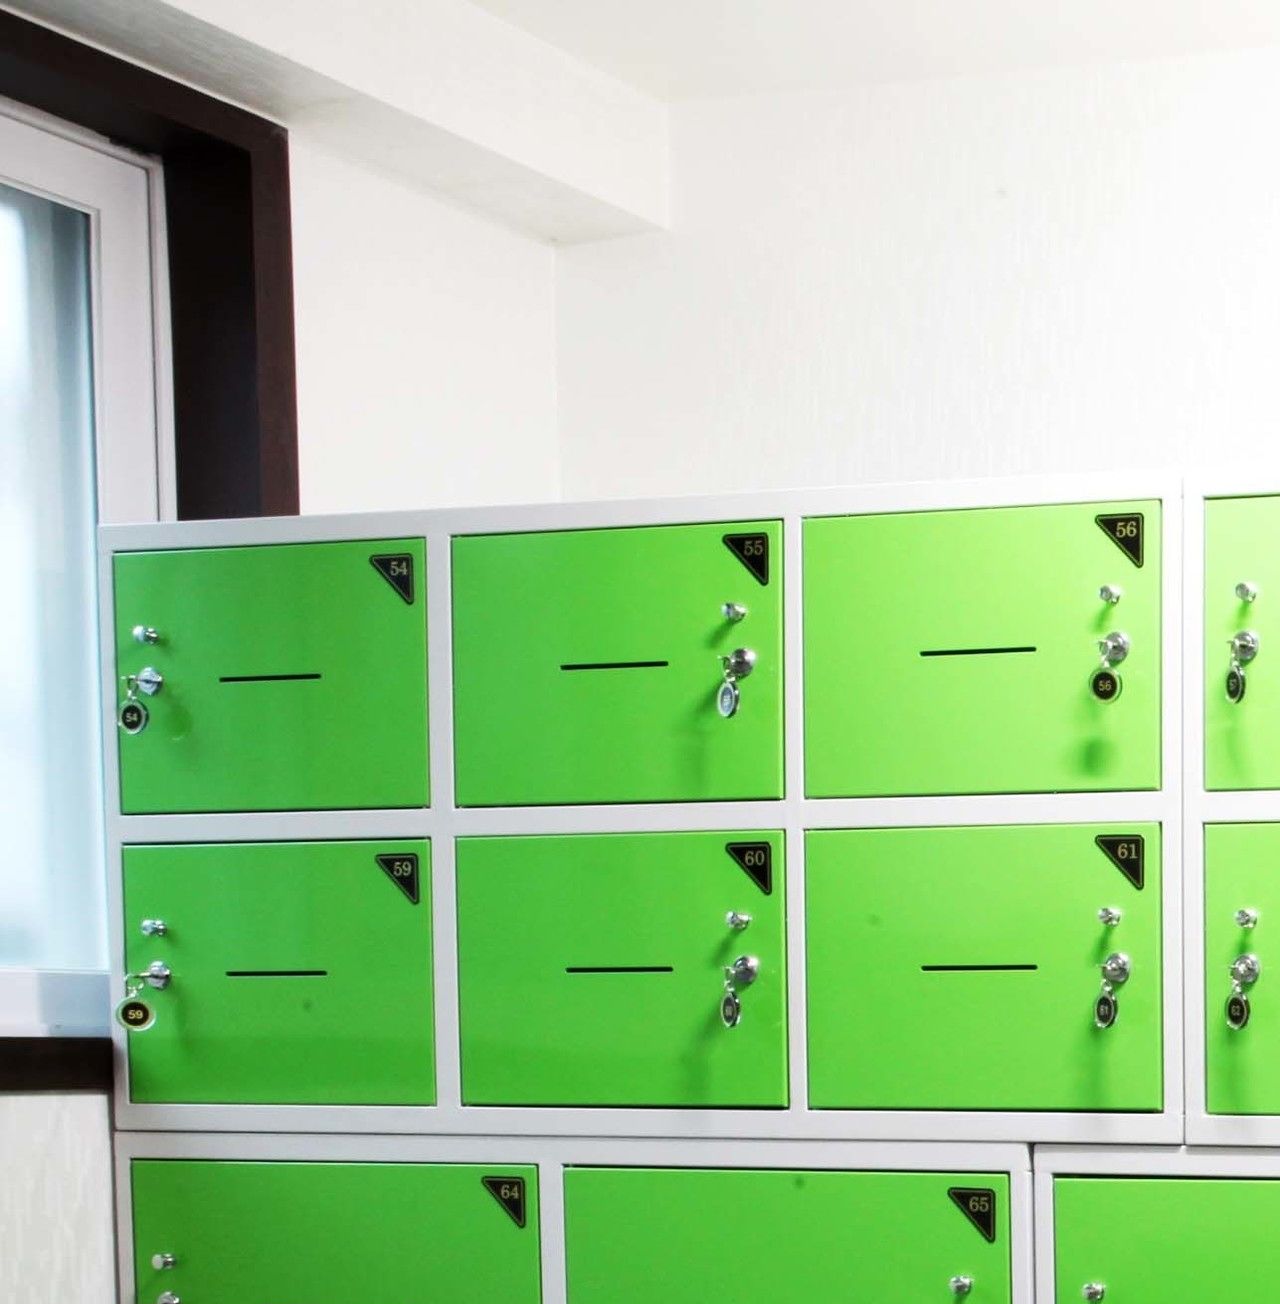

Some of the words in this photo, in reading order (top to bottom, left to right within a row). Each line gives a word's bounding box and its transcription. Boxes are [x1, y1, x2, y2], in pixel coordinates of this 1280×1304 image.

[1116, 521, 1136, 537] 56
[744, 540, 763, 555] 55
[390, 561, 407, 575] 54
[1098, 680, 1112, 692] 56
[745, 850, 765, 866] 60
[1117, 843, 1138, 859] 61
[393, 861, 412, 878] 59
[127, 1009, 144, 1020] 59
[499, 1184, 518, 1200] 64
[968, 1195, 989, 1213] 65
